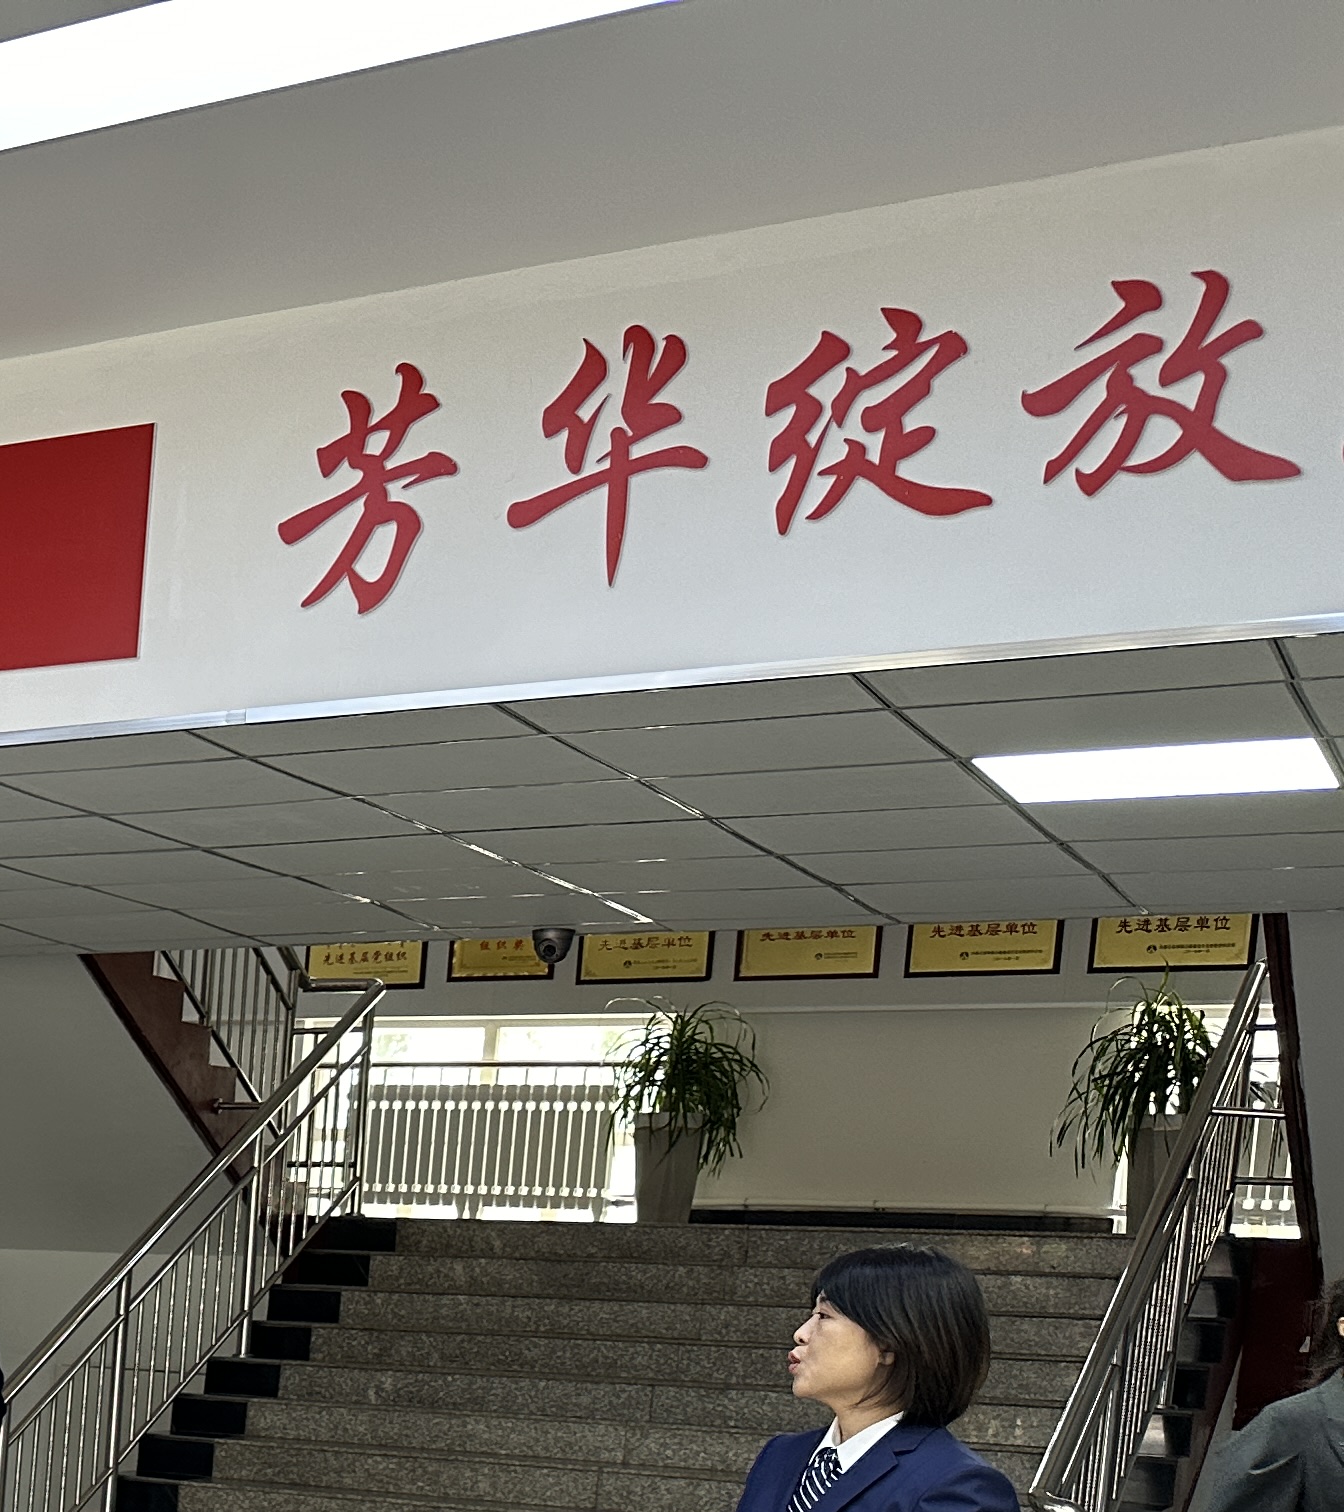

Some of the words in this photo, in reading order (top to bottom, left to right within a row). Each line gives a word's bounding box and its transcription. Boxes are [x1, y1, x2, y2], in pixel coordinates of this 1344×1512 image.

[278, 269, 1301, 616] 芳华绽放
[929, 921, 1038, 939] 先进基层单位
[1115, 915, 1232, 934] 先进基层单位
[598, 936, 693, 952] 先进基层单位
[759, 929, 857, 942] 先进基层单位
